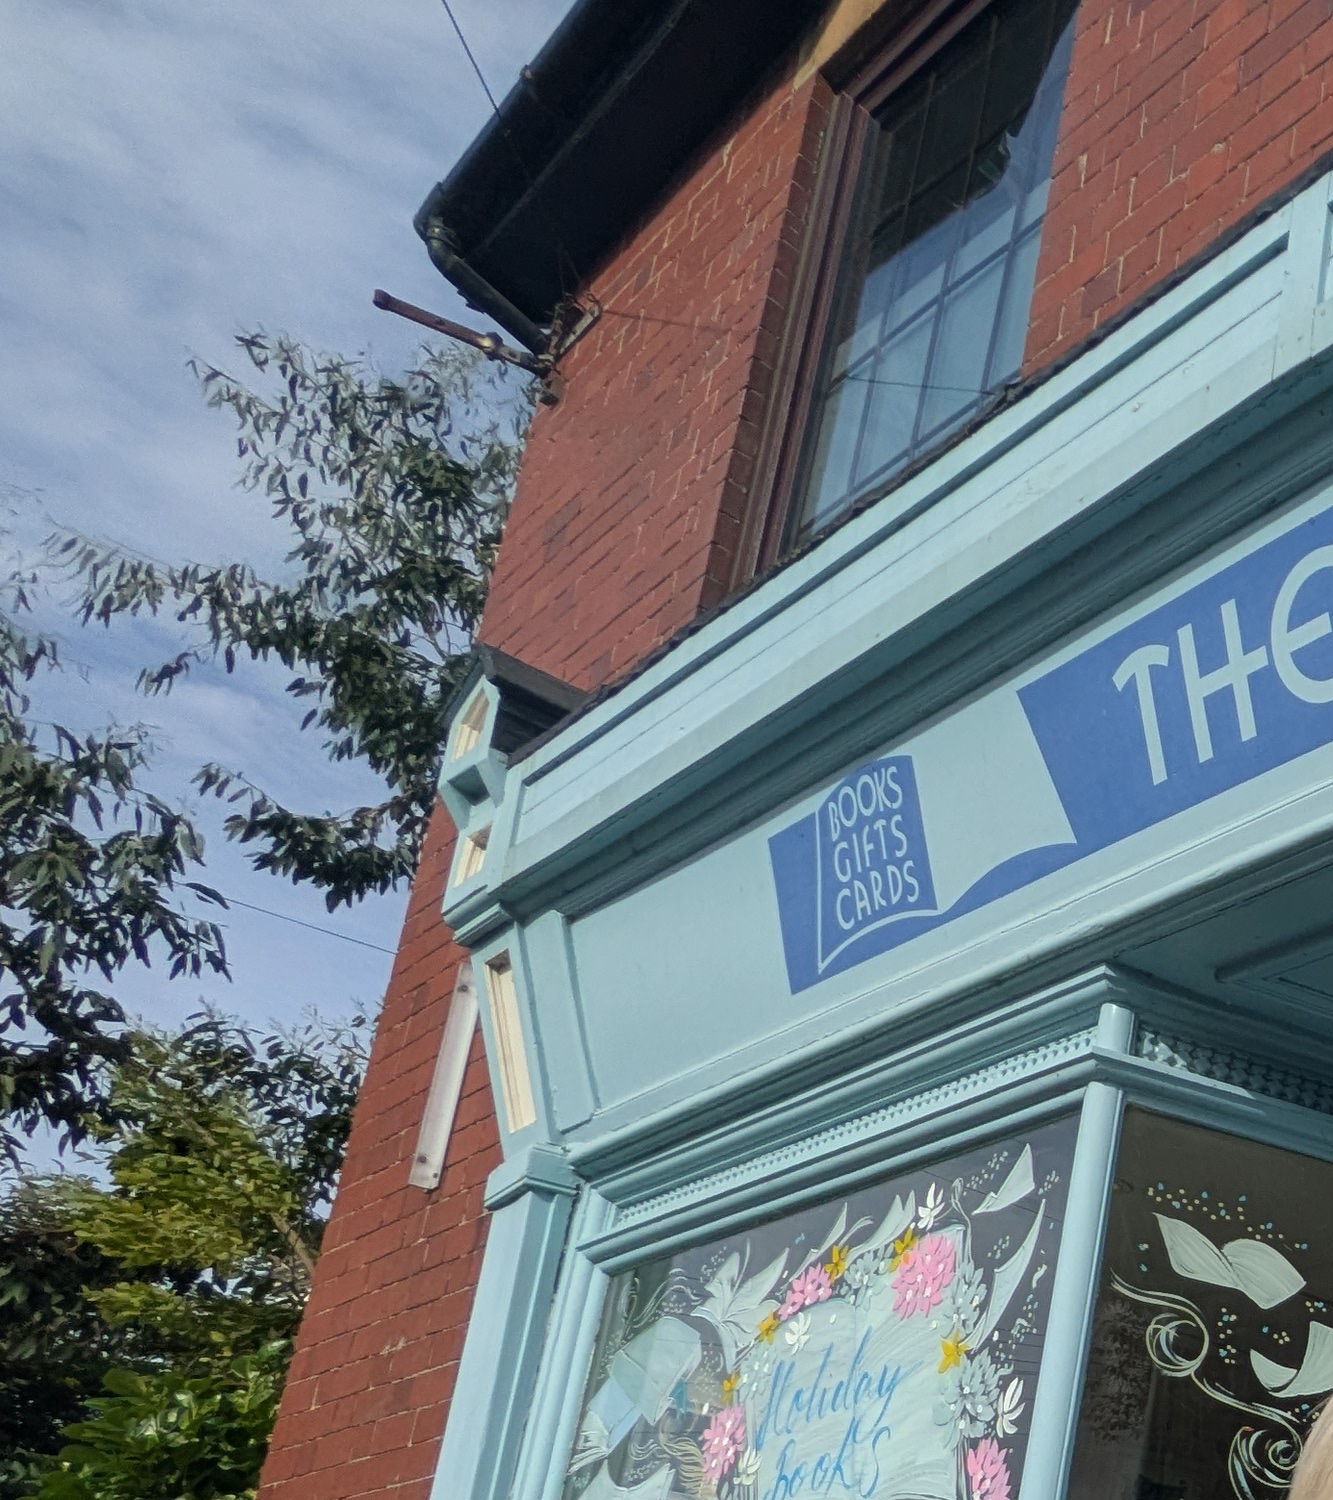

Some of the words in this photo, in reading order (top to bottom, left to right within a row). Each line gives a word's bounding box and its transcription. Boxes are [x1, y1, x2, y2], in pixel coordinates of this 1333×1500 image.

[828, 765, 903, 842] BOOKS
[834, 814, 908, 883] GIFTS
[836, 860, 920, 931] CARDS
[756, 1325, 926, 1451] Holiday
